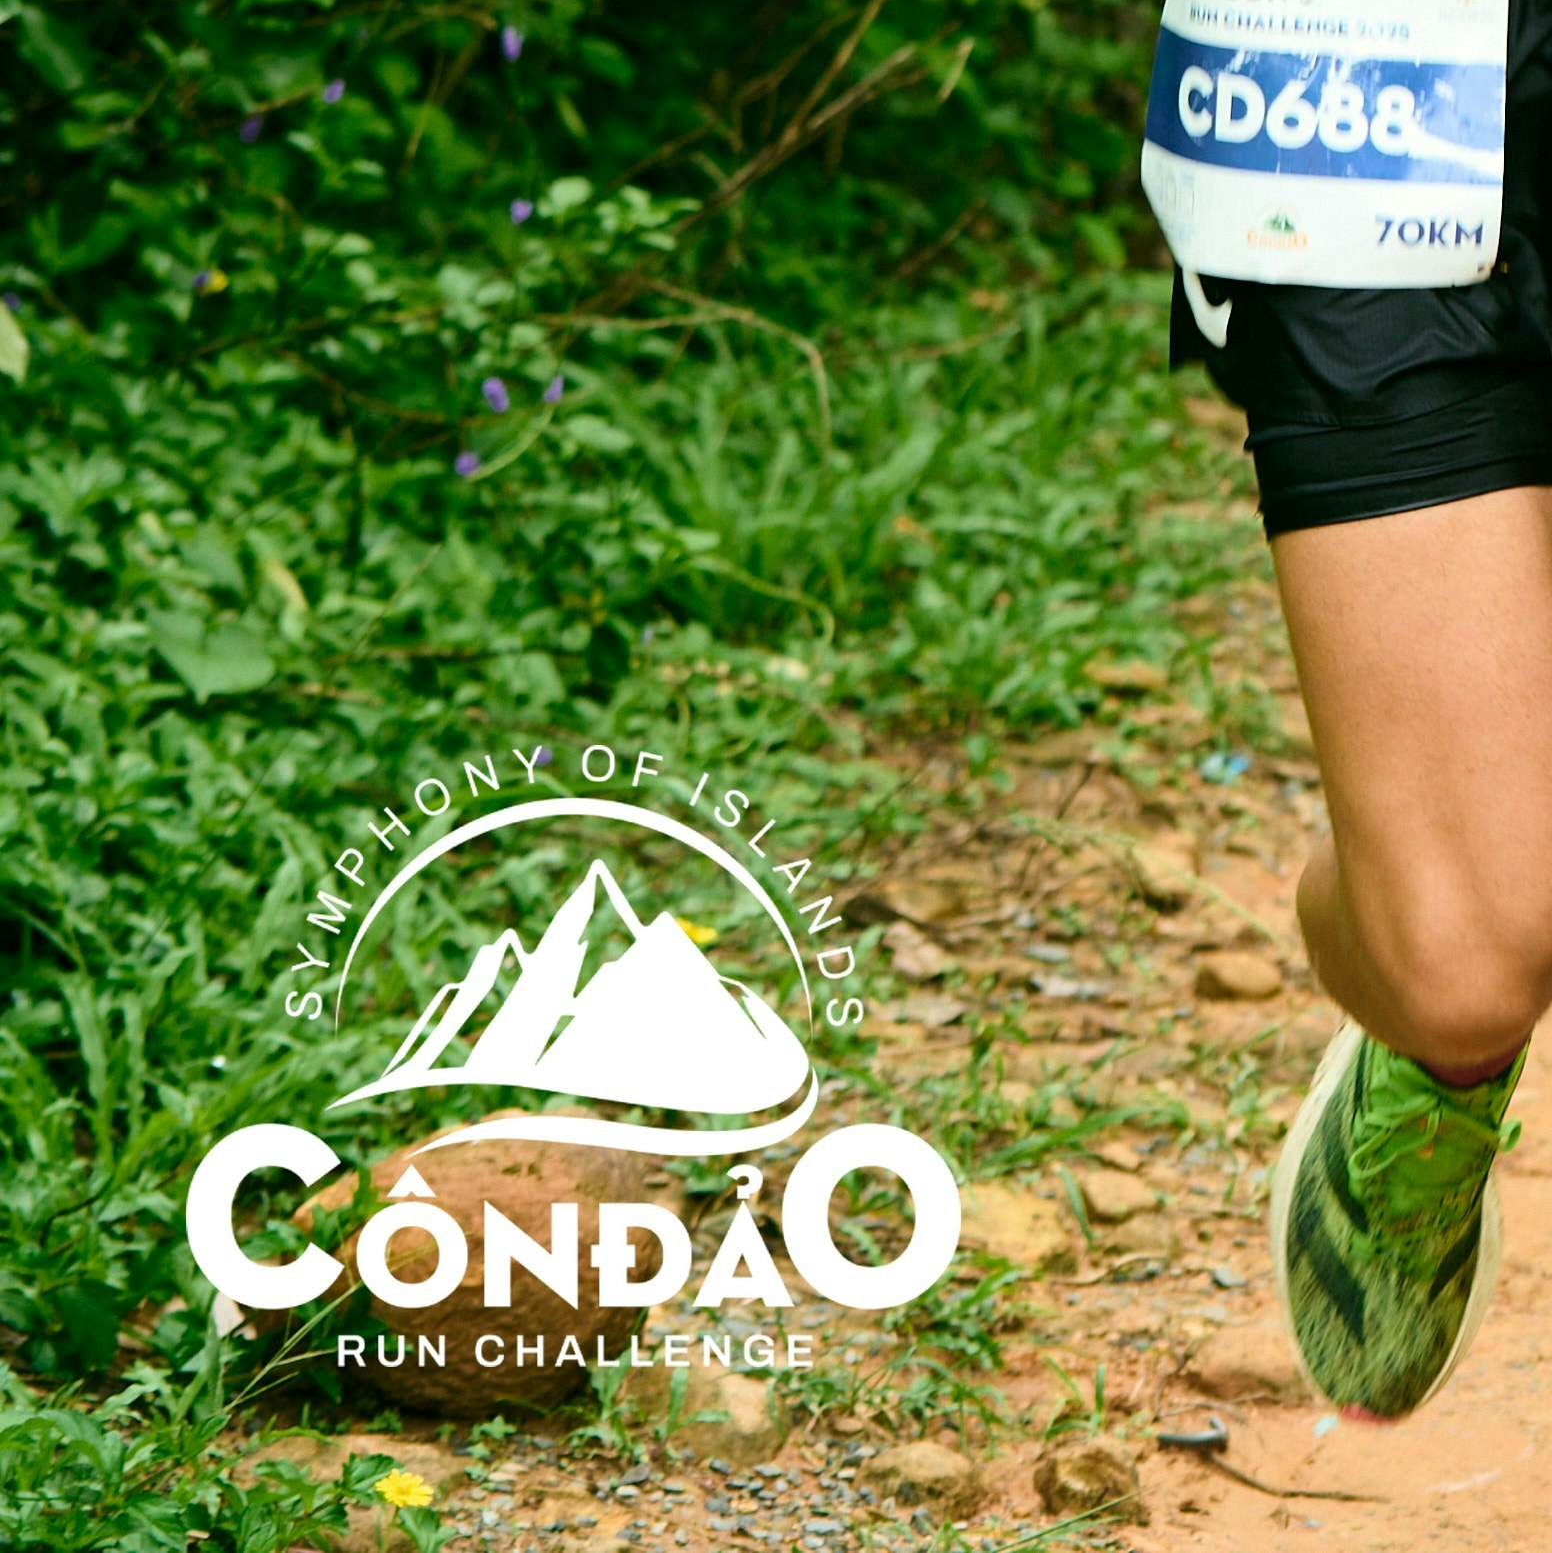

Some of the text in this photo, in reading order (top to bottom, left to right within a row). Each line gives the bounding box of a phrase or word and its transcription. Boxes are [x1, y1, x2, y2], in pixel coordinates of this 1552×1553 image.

[1224, 8, 1349, 37] CHALLENGE
[1178, 65, 1416, 156] CD688
[1376, 213, 1485, 249] 70KM
